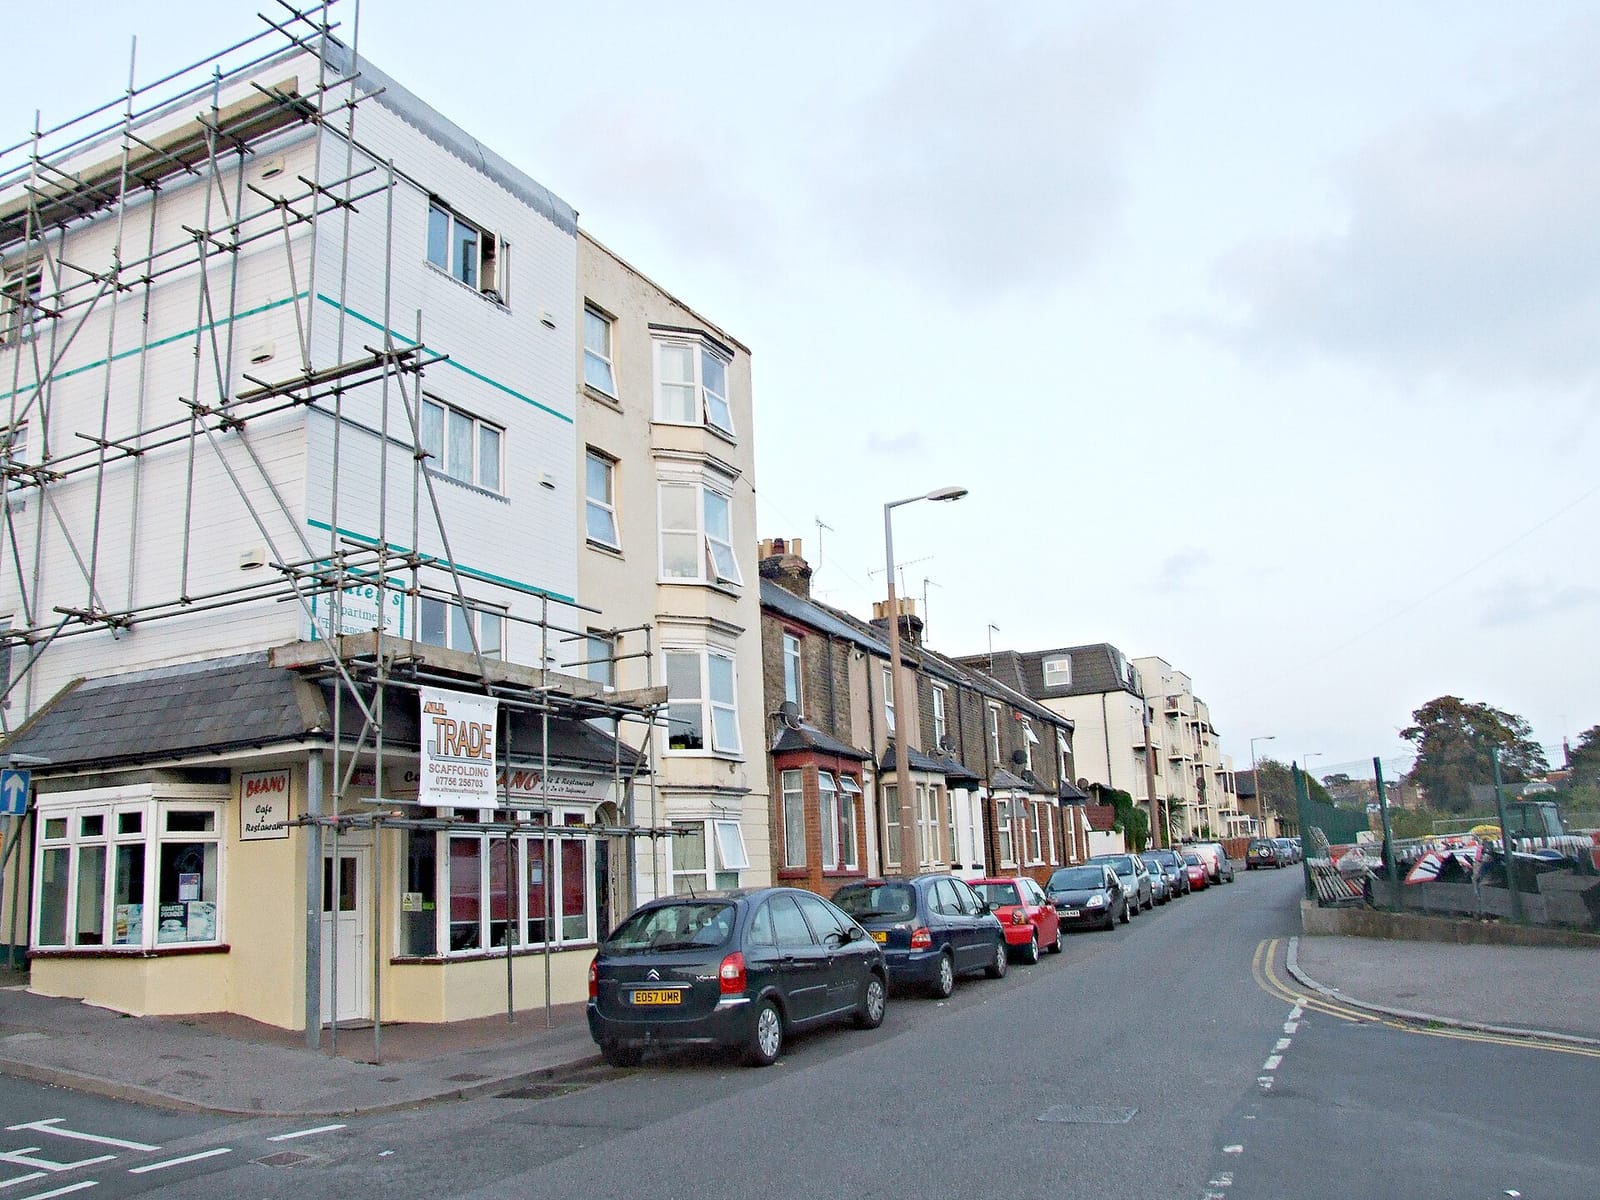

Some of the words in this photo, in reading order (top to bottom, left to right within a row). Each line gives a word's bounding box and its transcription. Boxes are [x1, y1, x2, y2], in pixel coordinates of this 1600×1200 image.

[324, 598, 392, 625] Apartmets
[423, 701, 447, 716] ALL
[432, 717, 493, 760] TRADE
[428, 763, 489, 778] SCAFFOLDING
[245, 775, 287, 799] BEANO
[661, 992, 680, 1002] UMR
